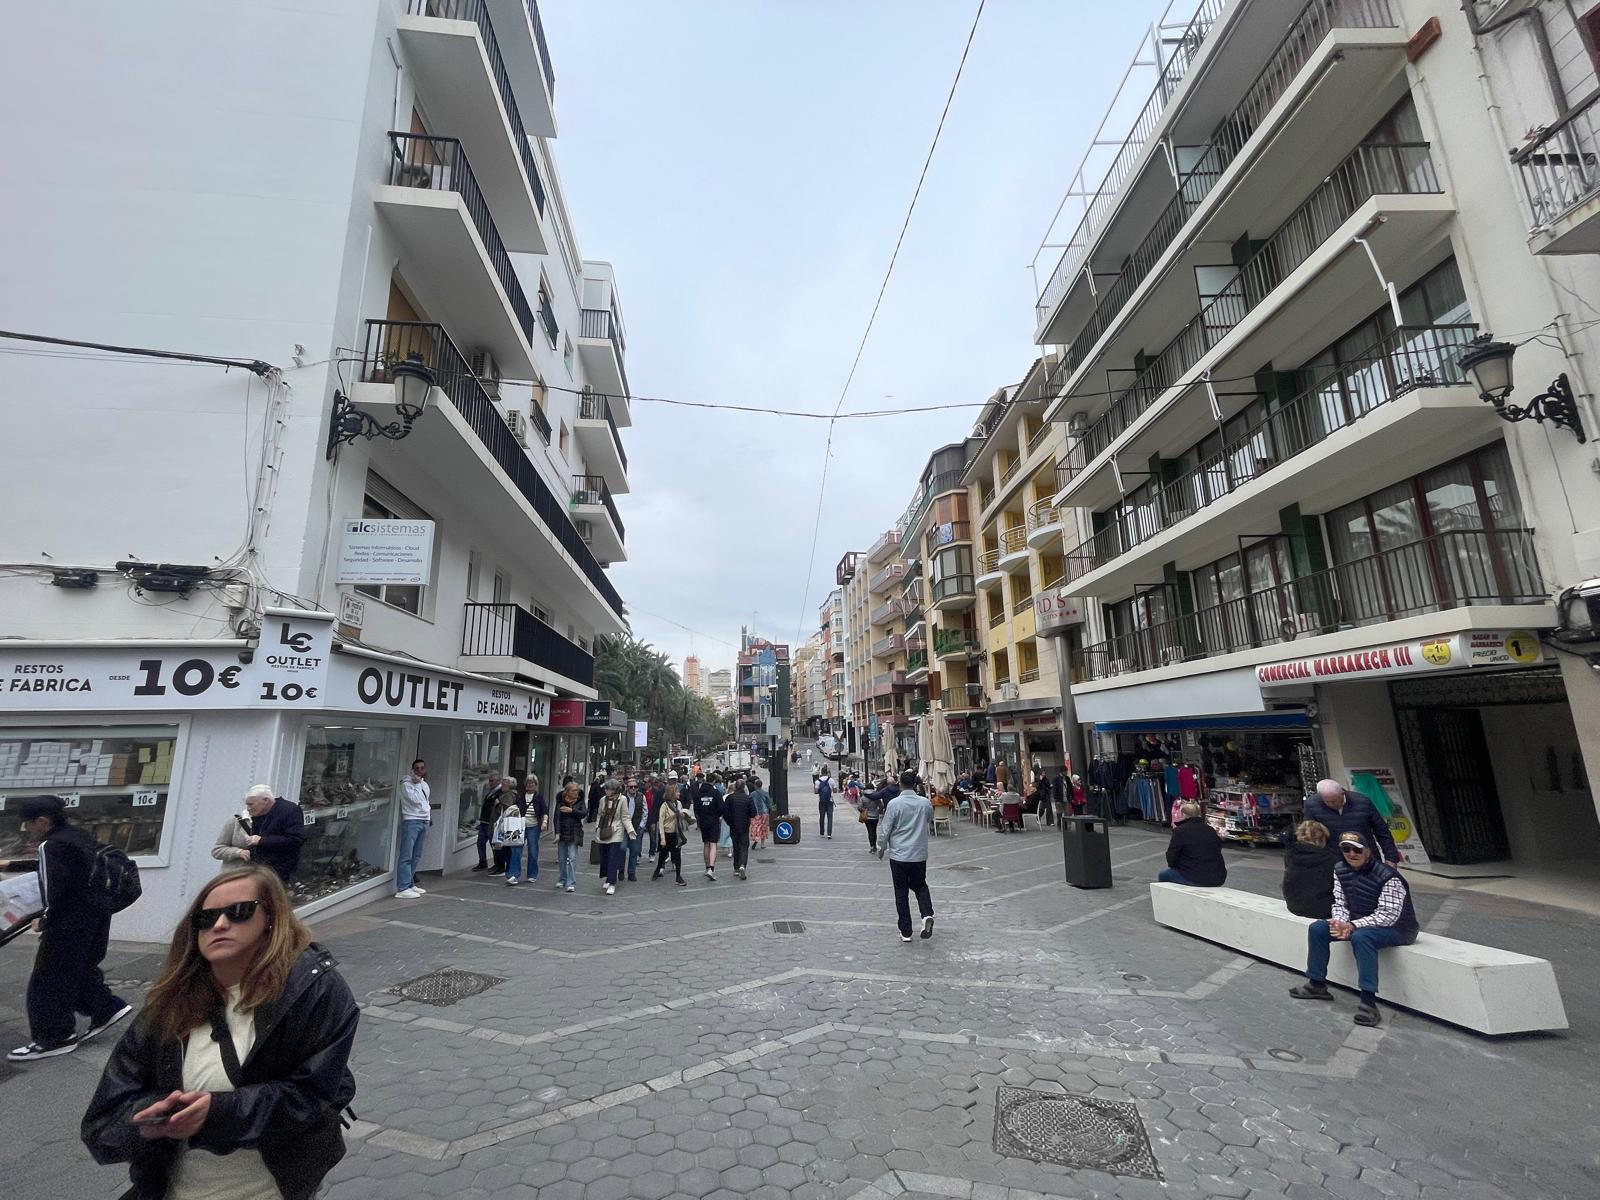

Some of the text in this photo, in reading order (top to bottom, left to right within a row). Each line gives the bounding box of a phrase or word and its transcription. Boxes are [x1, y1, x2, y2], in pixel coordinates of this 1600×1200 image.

[266, 655, 322, 667] OUTLET
[1472, 649, 1497, 658] PRECIO
[14, 664, 64, 674] RESTOS
[1258, 661, 1312, 683] COMERCIAL
[1313, 649, 1391, 676] MARRAKECH
[1393, 646, 1413, 667] III
[9, 678, 92, 692] FABRICA
[134, 659, 243, 696] 10€
[260, 682, 318, 701] 10€
[357, 667, 464, 712] OUTLET
[477, 700, 518, 717] DE FABRICA
[491, 689, 512, 700] RESTOS
[526, 696, 545, 720] 10€
[137, 794, 154, 805] 10€
[304, 815, 314, 825] 10€
